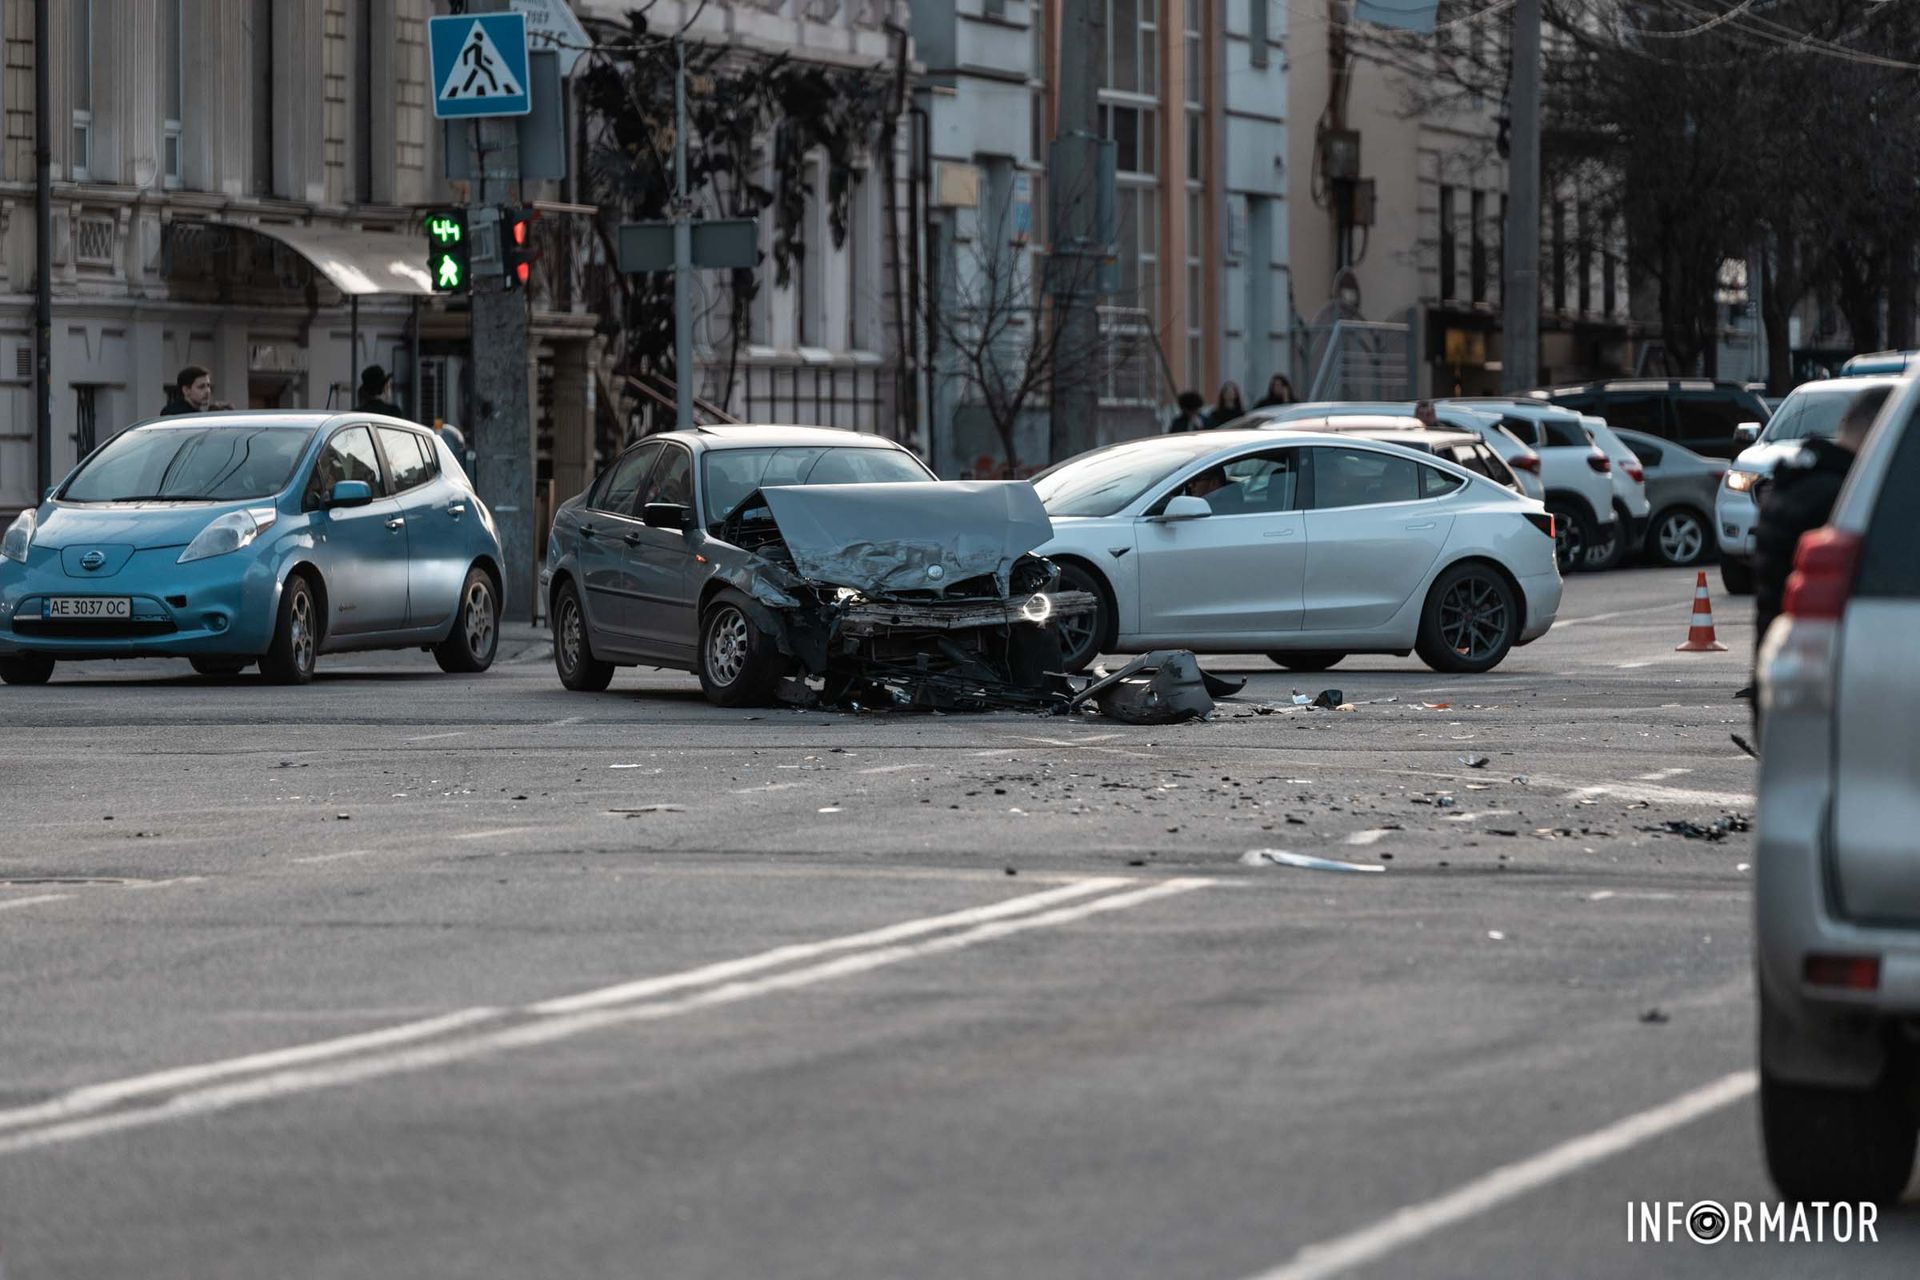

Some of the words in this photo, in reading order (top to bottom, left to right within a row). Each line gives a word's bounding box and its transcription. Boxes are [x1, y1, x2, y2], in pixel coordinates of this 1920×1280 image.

[432, 219, 460, 242] 44
[50, 600, 70, 615] AE
[73, 600, 103, 615] 3037
[106, 600, 126, 615] OC
